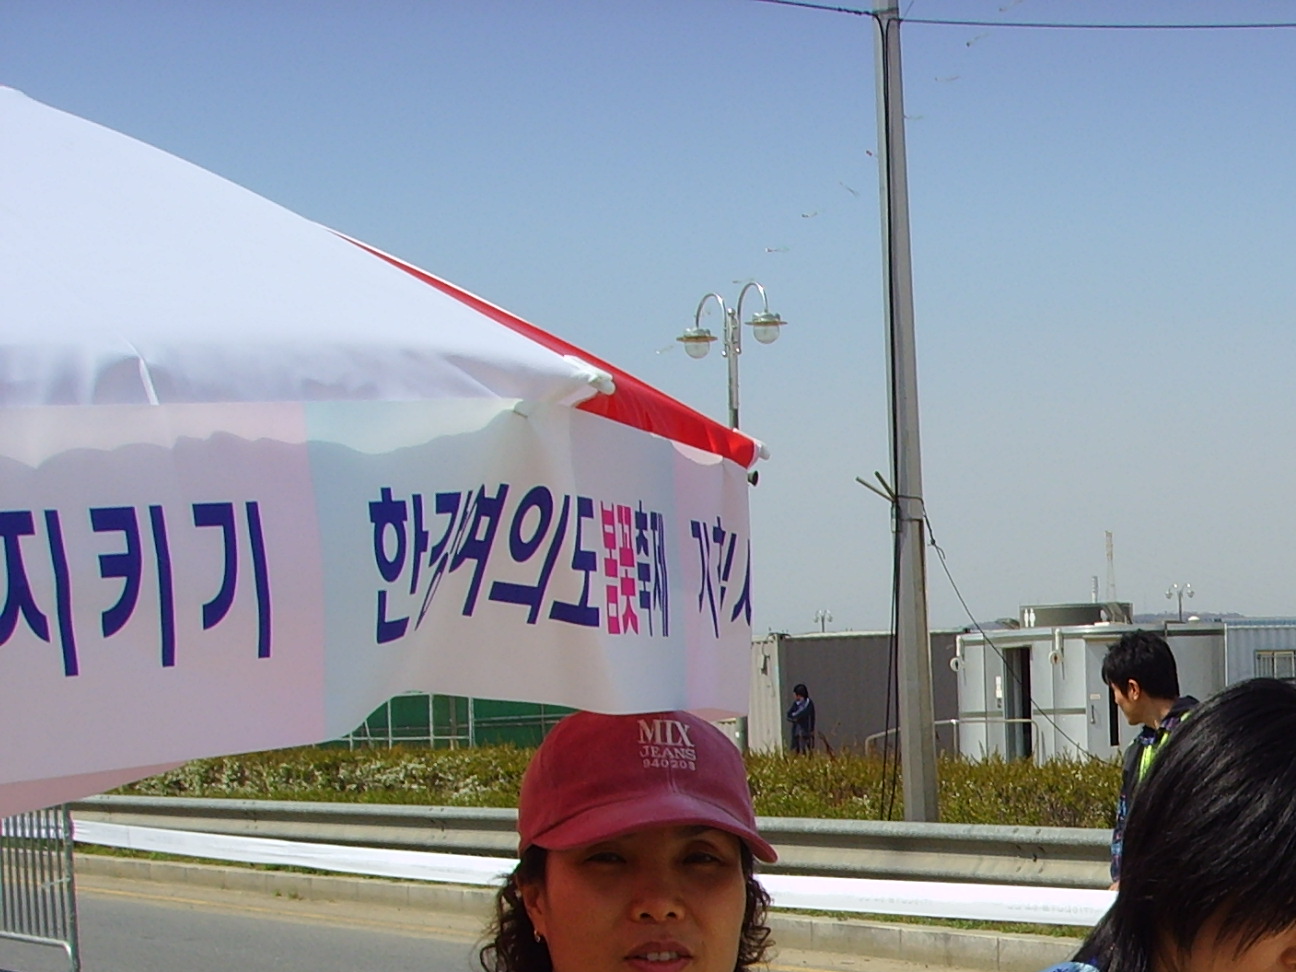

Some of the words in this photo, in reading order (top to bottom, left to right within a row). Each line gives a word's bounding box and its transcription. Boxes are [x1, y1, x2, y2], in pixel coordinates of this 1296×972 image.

[0, 501, 273, 677] 지키기
[637, 719, 696, 748] MIX
[640, 745, 696, 761] JEANS
